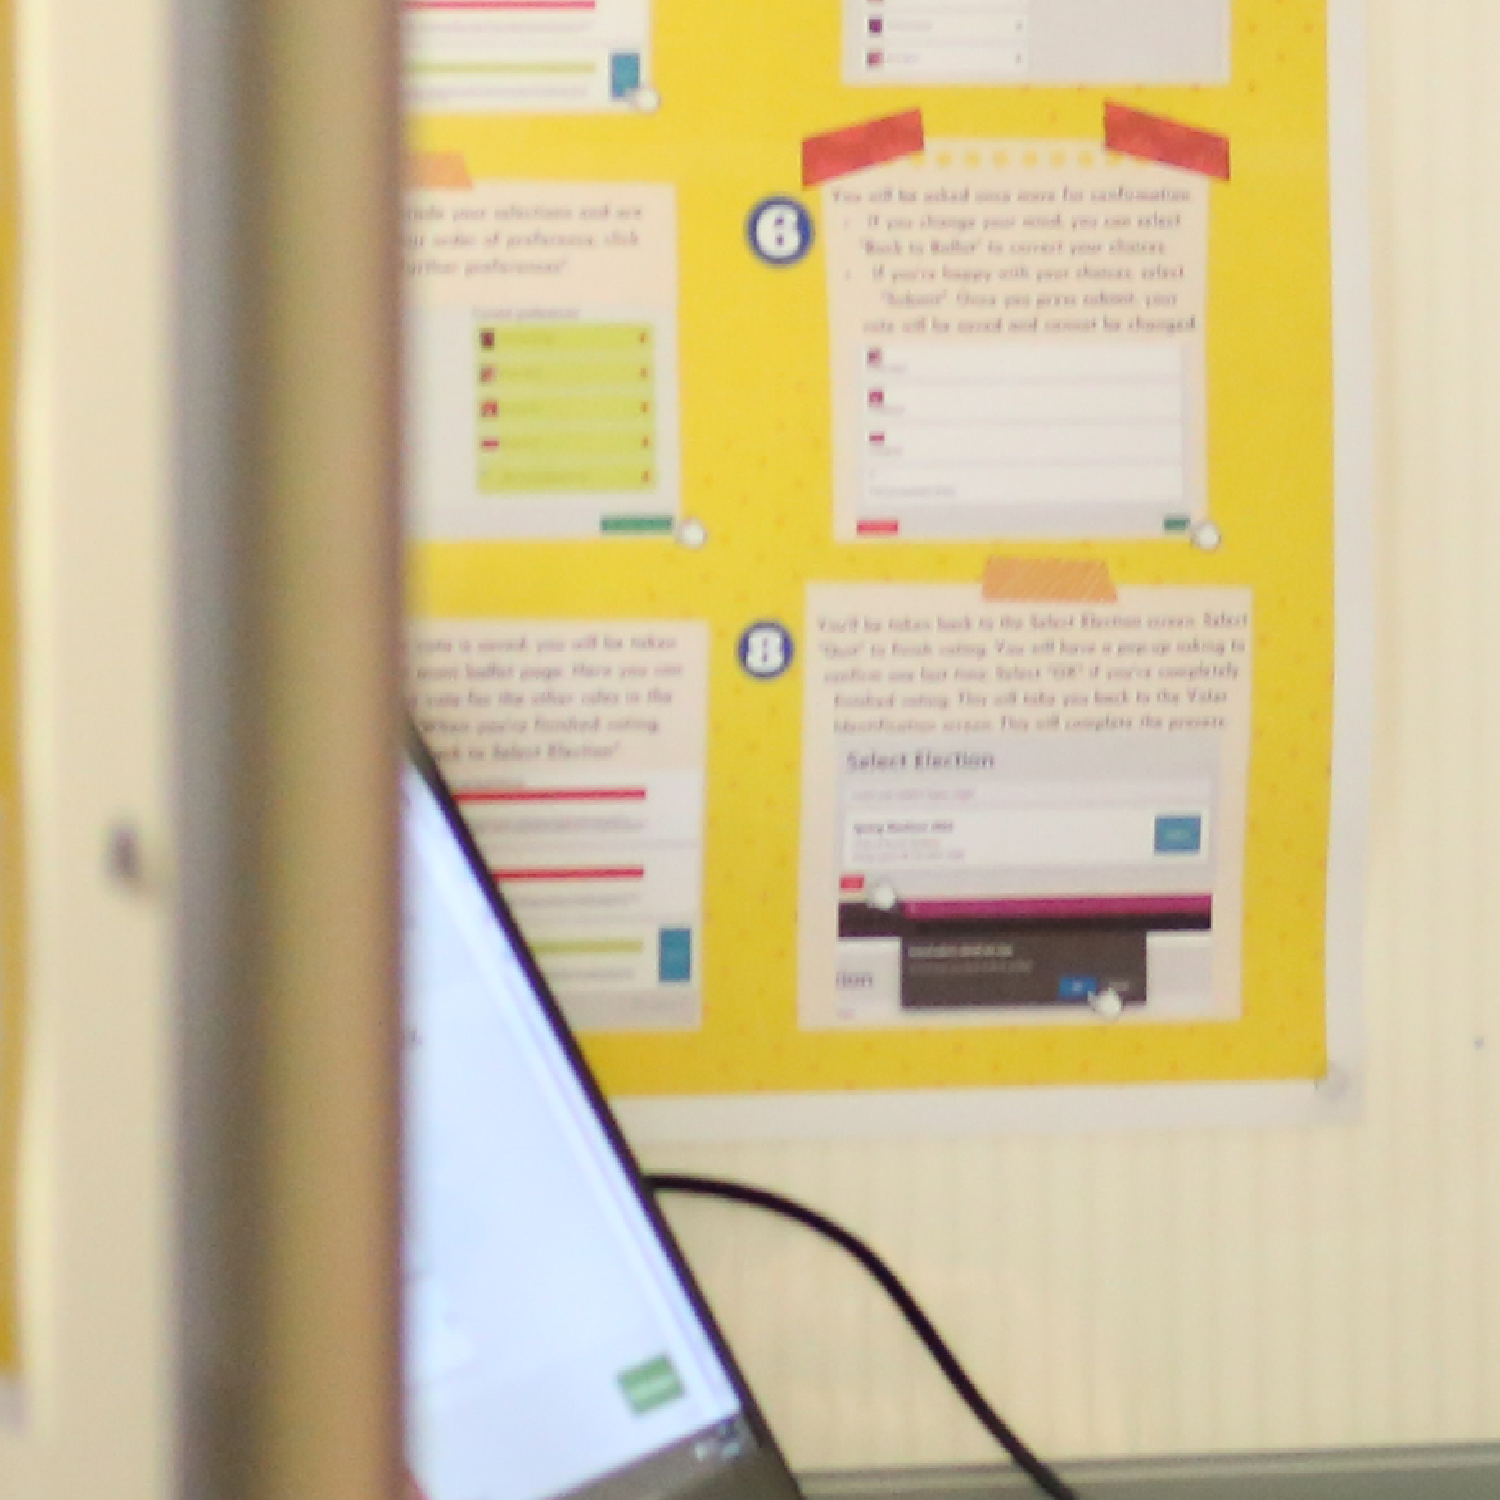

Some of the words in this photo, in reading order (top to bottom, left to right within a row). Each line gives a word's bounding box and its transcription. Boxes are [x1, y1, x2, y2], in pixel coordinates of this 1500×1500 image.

[755, 204, 803, 259] 6
[747, 631, 785, 669] 8
[846, 752, 906, 771] Select
[915, 752, 995, 771] Election
